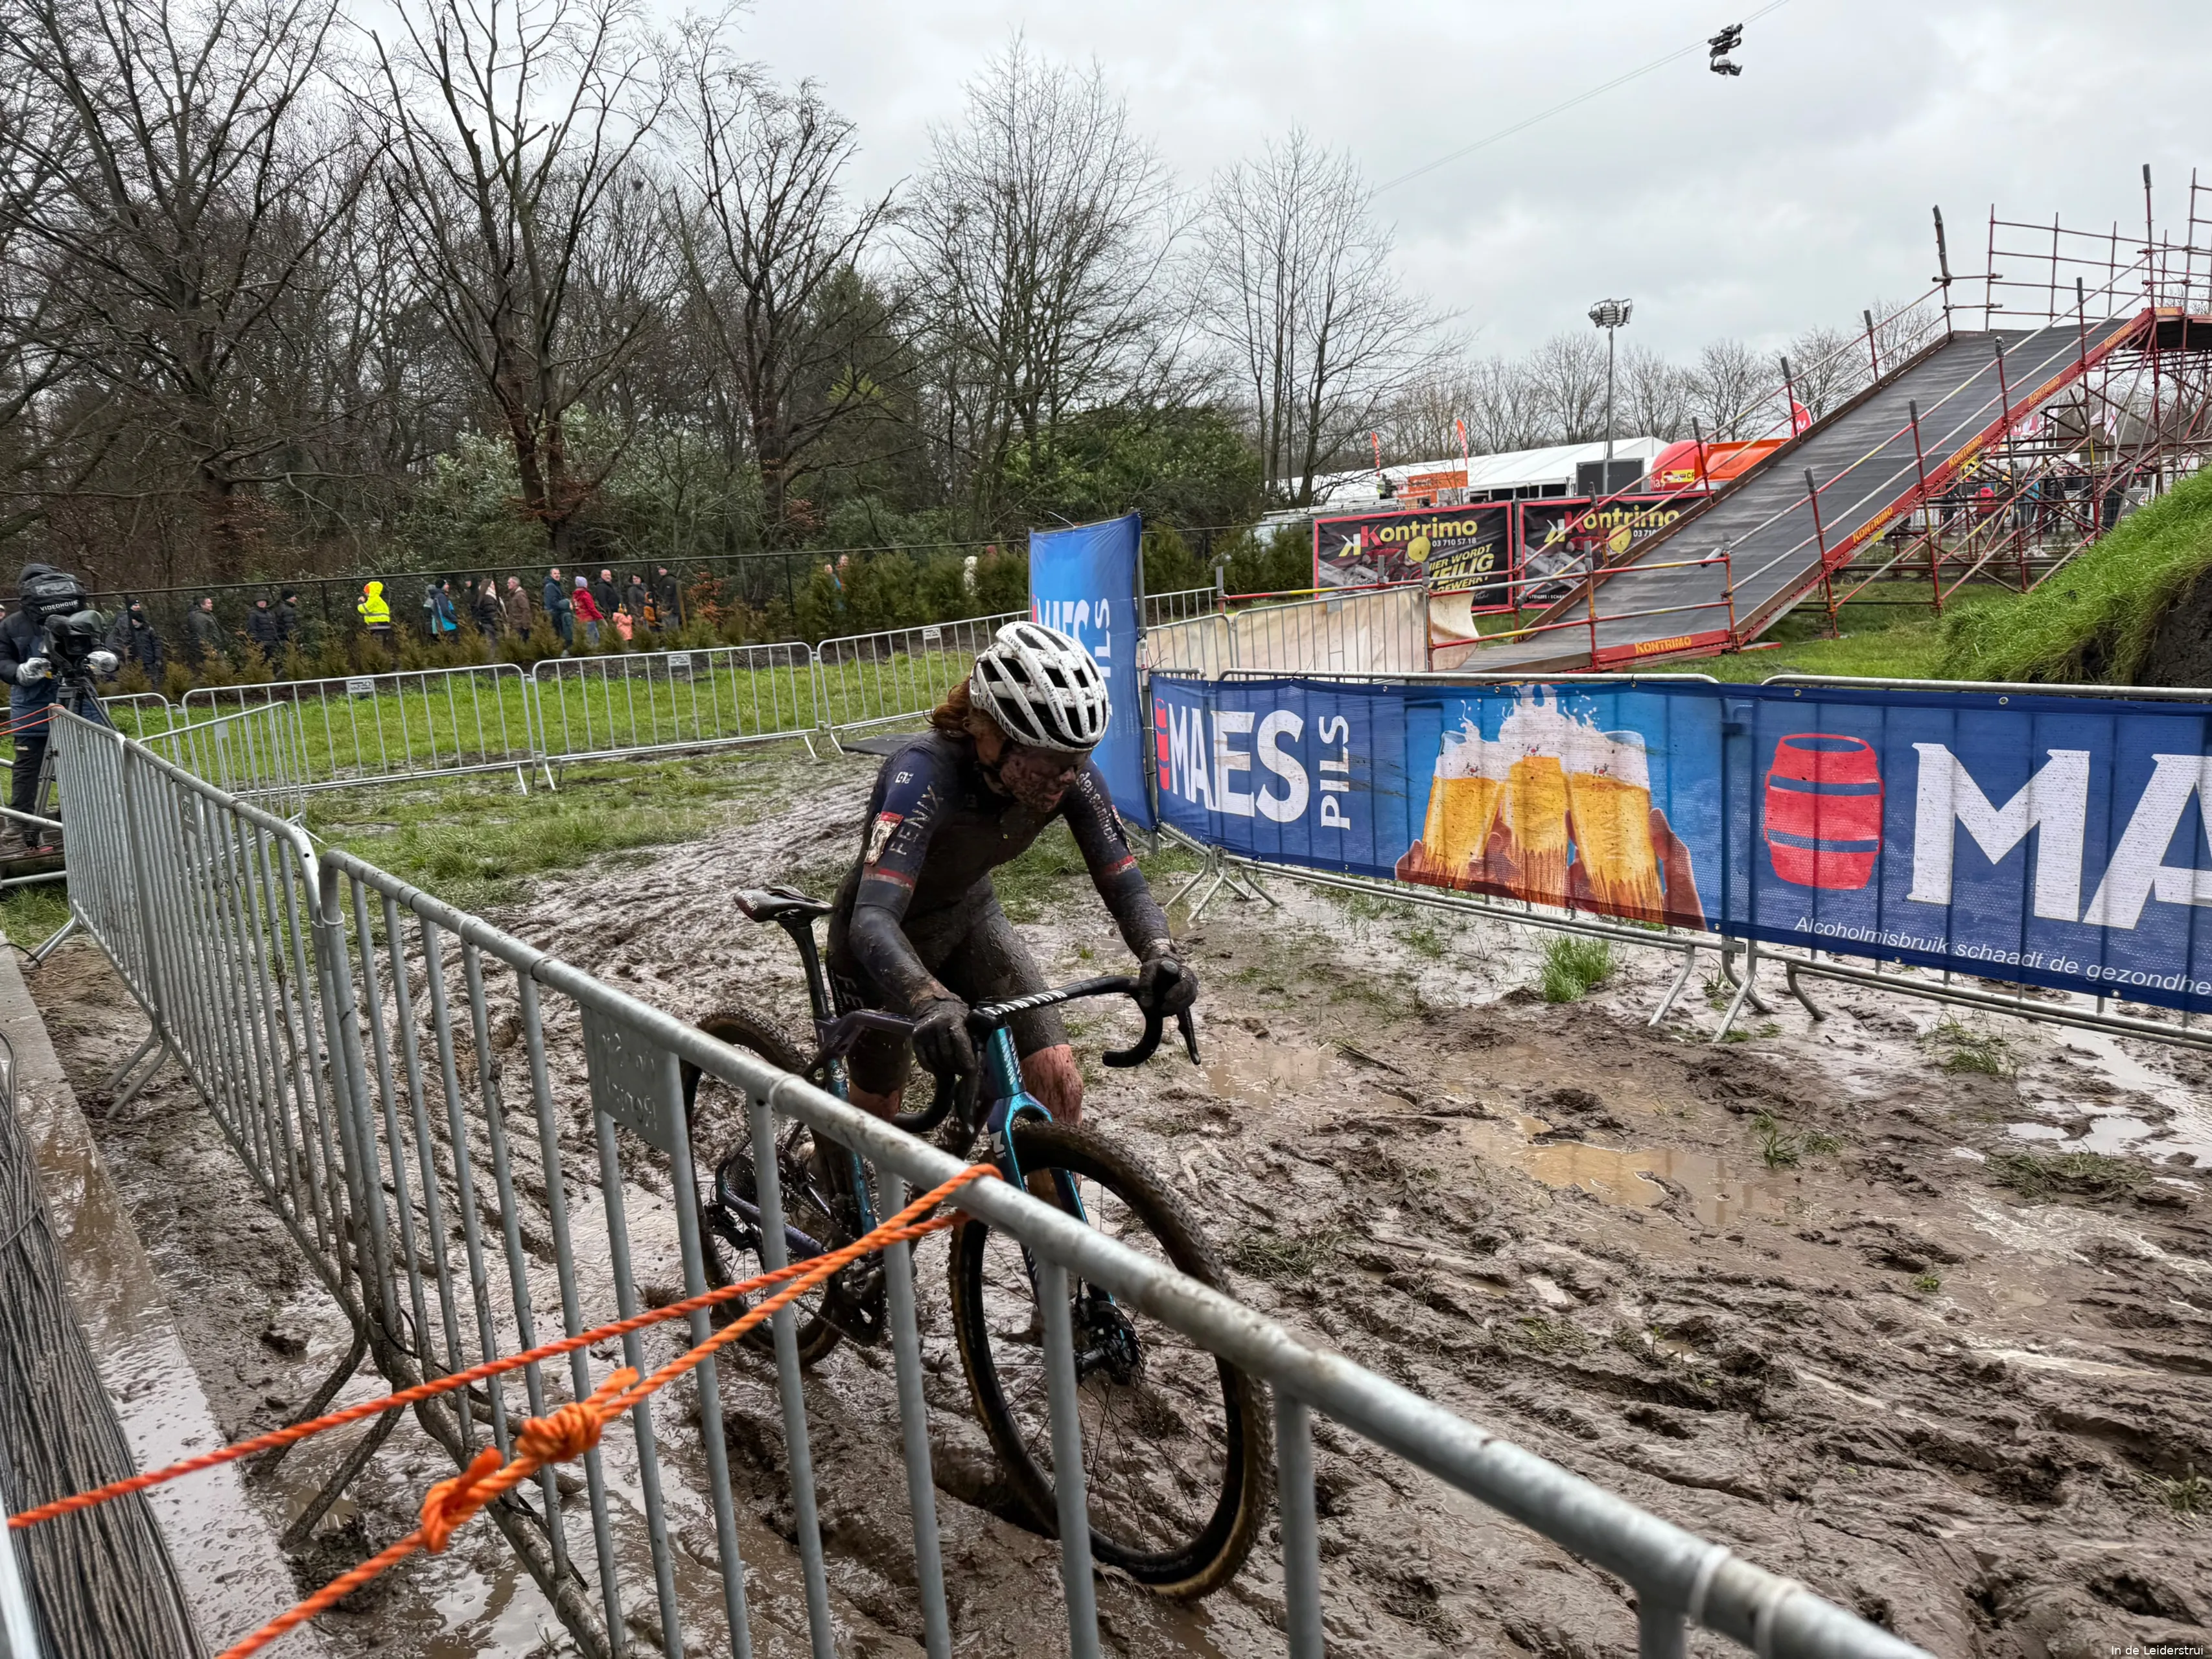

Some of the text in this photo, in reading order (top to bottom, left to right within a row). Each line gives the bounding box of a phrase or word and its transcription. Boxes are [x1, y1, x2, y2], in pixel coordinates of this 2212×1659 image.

[1948, 435, 1983, 468] KONTRIMO
[1361, 516, 1478, 548] Kontrimo
[1564, 505, 1680, 534] Kontrimo
[1852, 506, 1893, 543] KONTRIMO
[1451, 543, 1493, 564] WORDT
[1635, 636, 1692, 655] KONTRIMO
[1168, 703, 1310, 823] MAES
[1318, 715, 1351, 831] PILS
[1794, 916, 2212, 996] Alcoholmisbruik schaadt de gezondhe
[981, 990, 1068, 1015] CANYON
